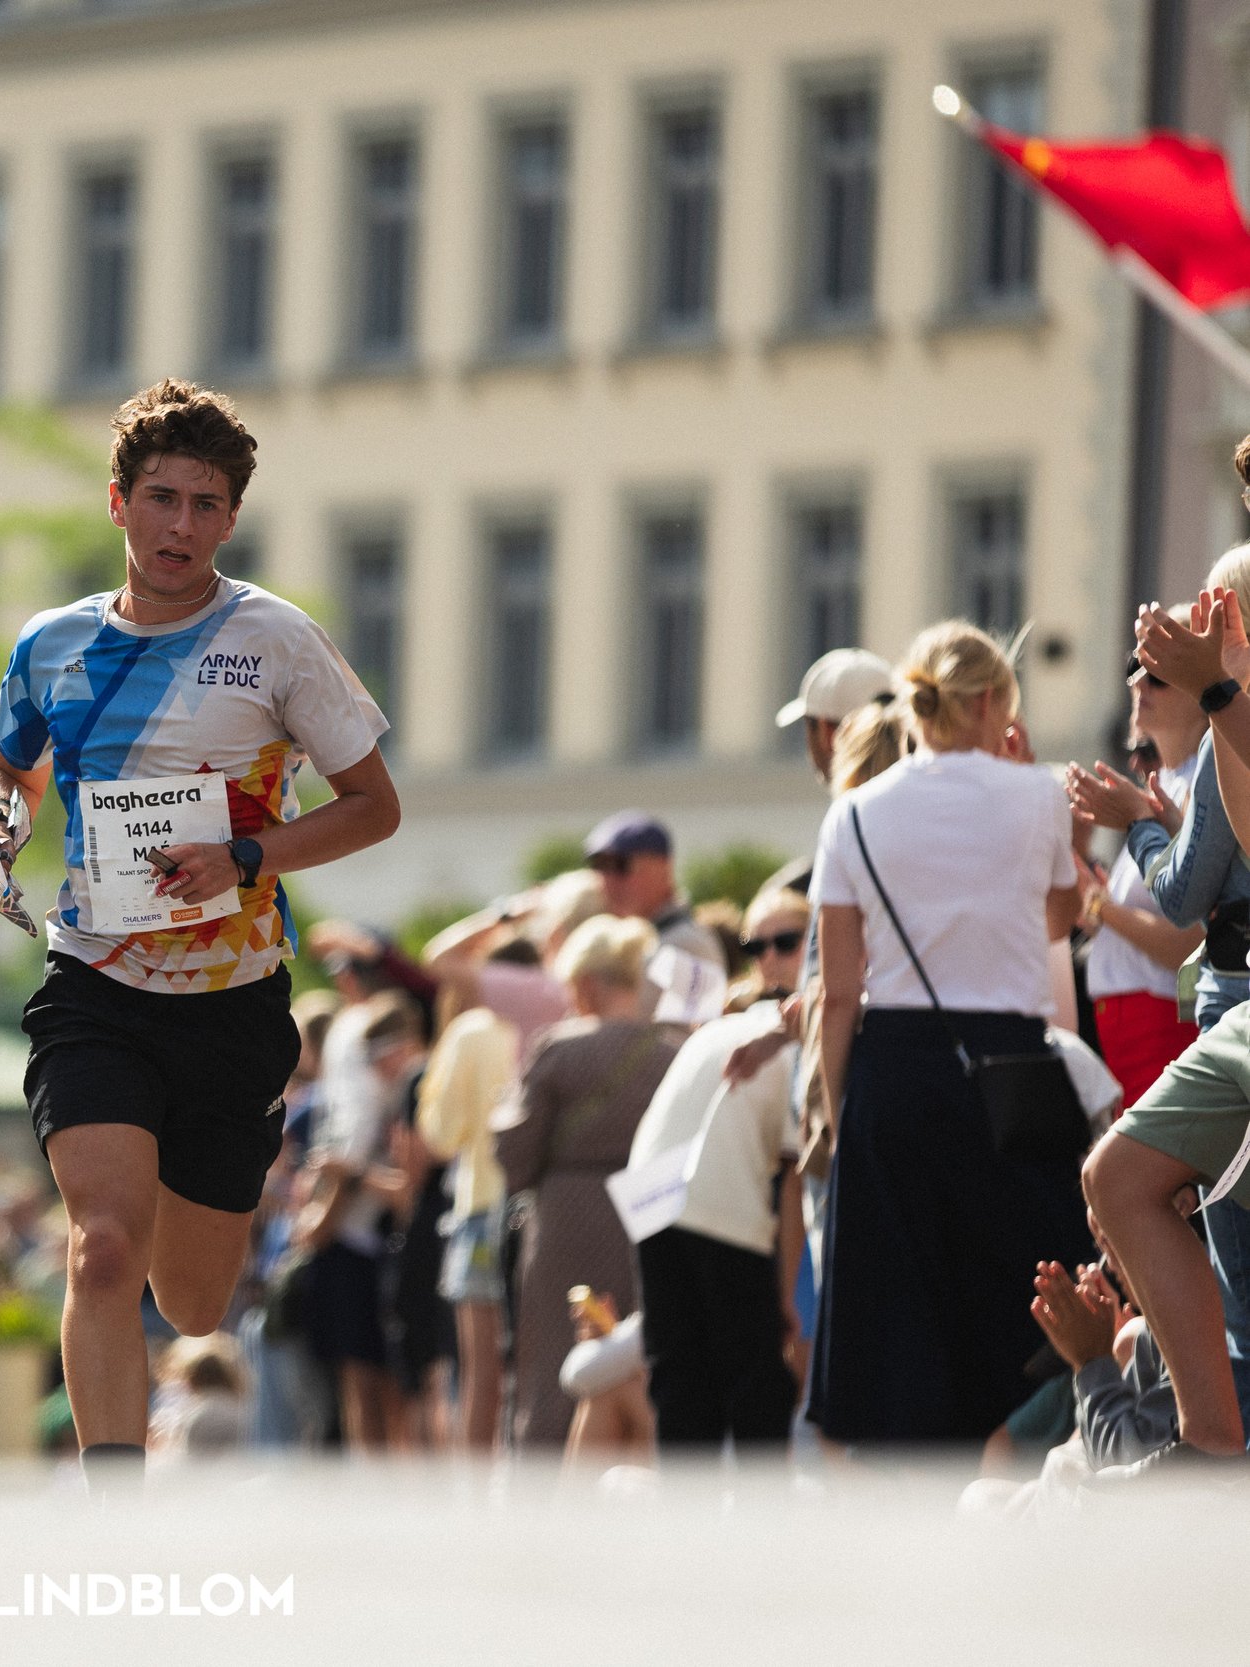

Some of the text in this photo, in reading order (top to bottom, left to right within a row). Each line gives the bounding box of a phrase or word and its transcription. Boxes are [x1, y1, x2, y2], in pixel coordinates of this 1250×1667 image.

[200, 654, 262, 671] ARNAY
[198, 670, 260, 689] LE DUC
[92, 788, 201, 812] bagheera
[125, 820, 172, 837] 14144
[123, 914, 162, 923] CHALMERS
